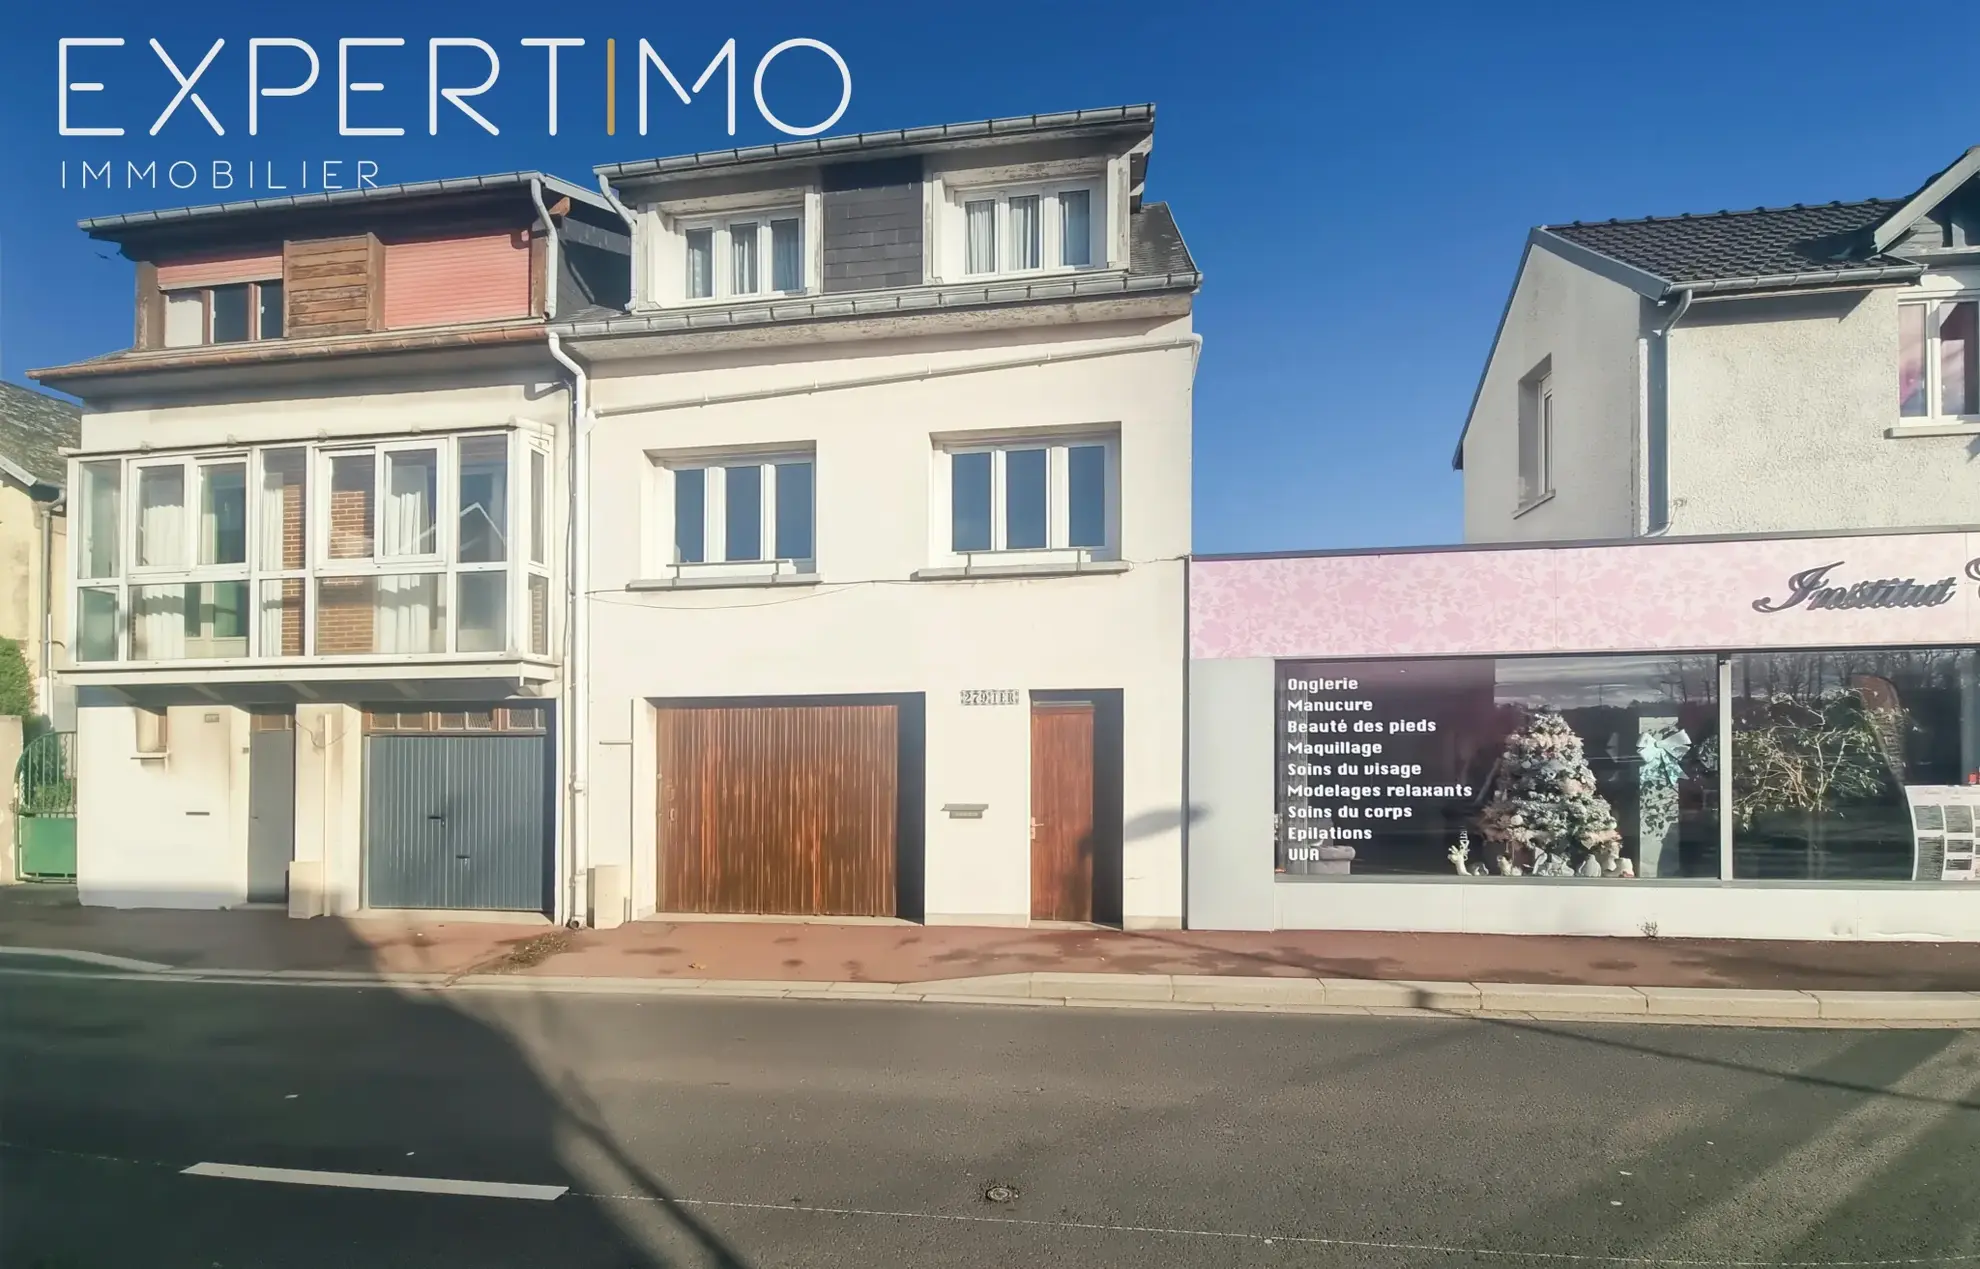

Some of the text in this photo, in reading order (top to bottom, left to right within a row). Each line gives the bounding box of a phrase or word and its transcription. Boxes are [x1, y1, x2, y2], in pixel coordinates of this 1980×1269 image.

[1752, 561, 1958, 613] Institut
[1288, 678, 1358, 693] Onglerie
[1288, 700, 1373, 712] Manucure
[1288, 719, 1436, 734] Beauté des pieds
[1288, 742, 1382, 757] Maquillage
[1288, 763, 1421, 778] Soins du visage
[1288, 784, 1472, 800] Modelages relaxants
[1288, 806, 1412, 819] Soins du corps
[1288, 827, 1372, 840] Epilations
